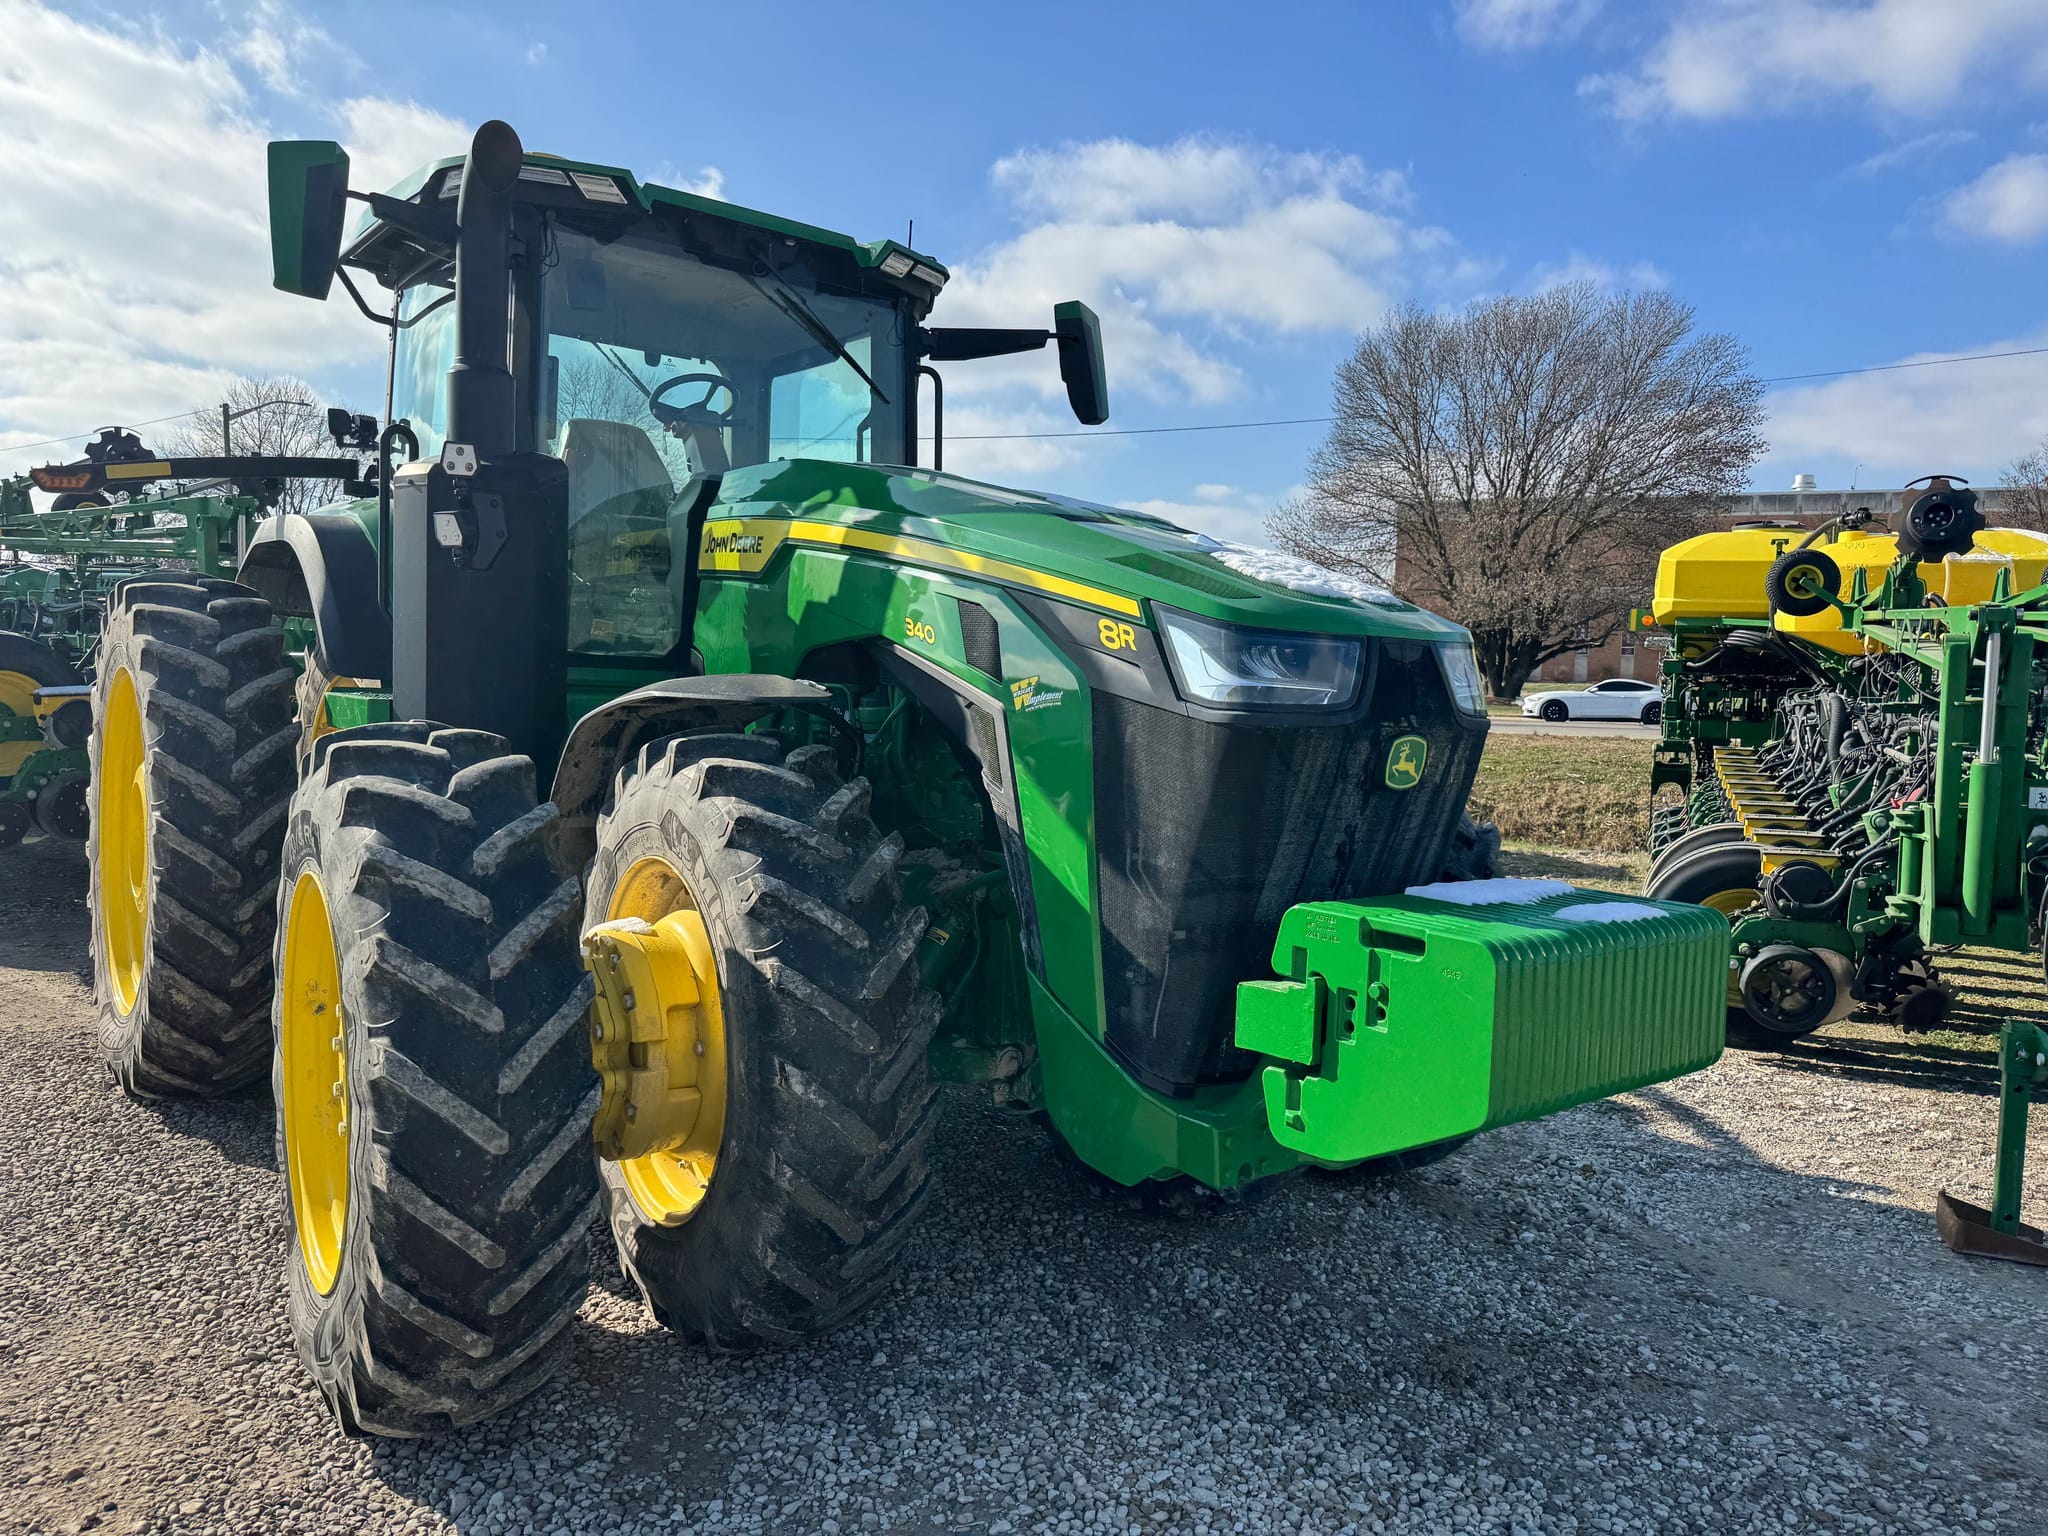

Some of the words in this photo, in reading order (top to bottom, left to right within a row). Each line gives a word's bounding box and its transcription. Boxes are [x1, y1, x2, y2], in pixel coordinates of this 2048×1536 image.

[705, 533, 728, 553] JOHN
[729, 532, 763, 554] DEERE
[904, 616, 936, 645] 340
[1098, 618, 1136, 651] 8R
